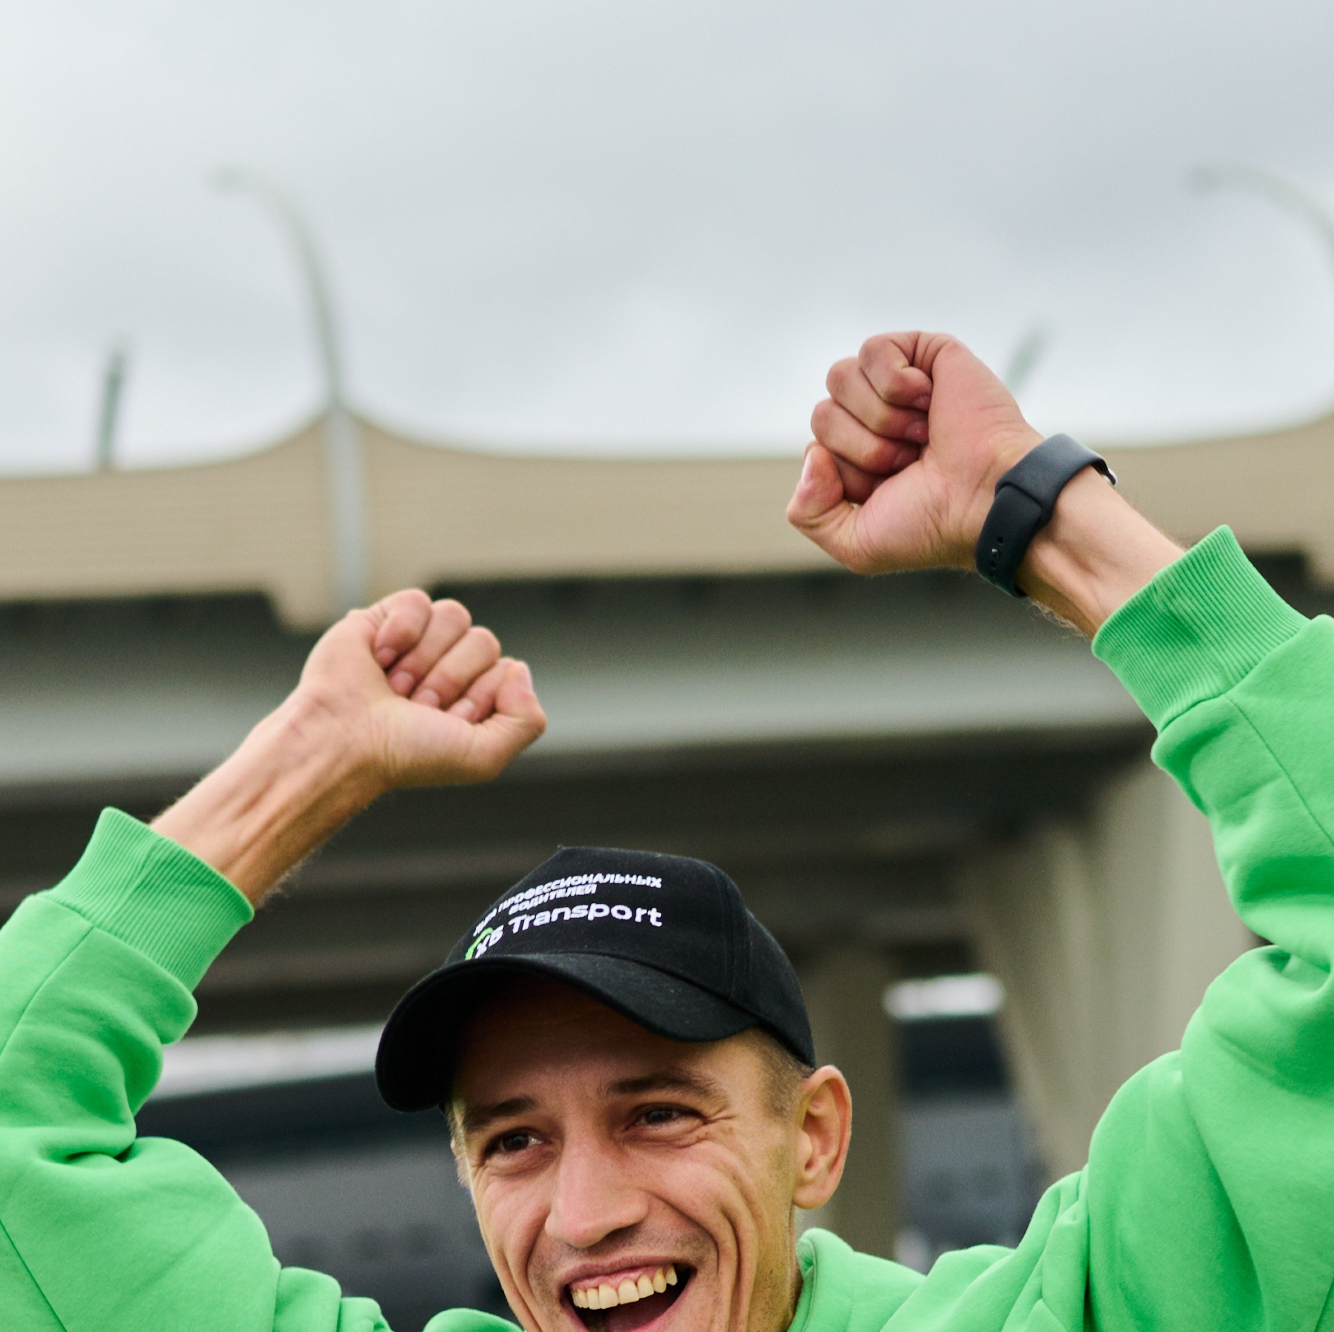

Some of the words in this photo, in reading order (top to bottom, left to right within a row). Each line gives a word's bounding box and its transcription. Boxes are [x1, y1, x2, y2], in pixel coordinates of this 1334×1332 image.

[498, 873, 662, 913] ПРОФЕССИОНАЛЬНЫХ
[508, 883, 598, 915] ВОДИТЕЛЕЙ
[508, 903, 663, 934] Transport
